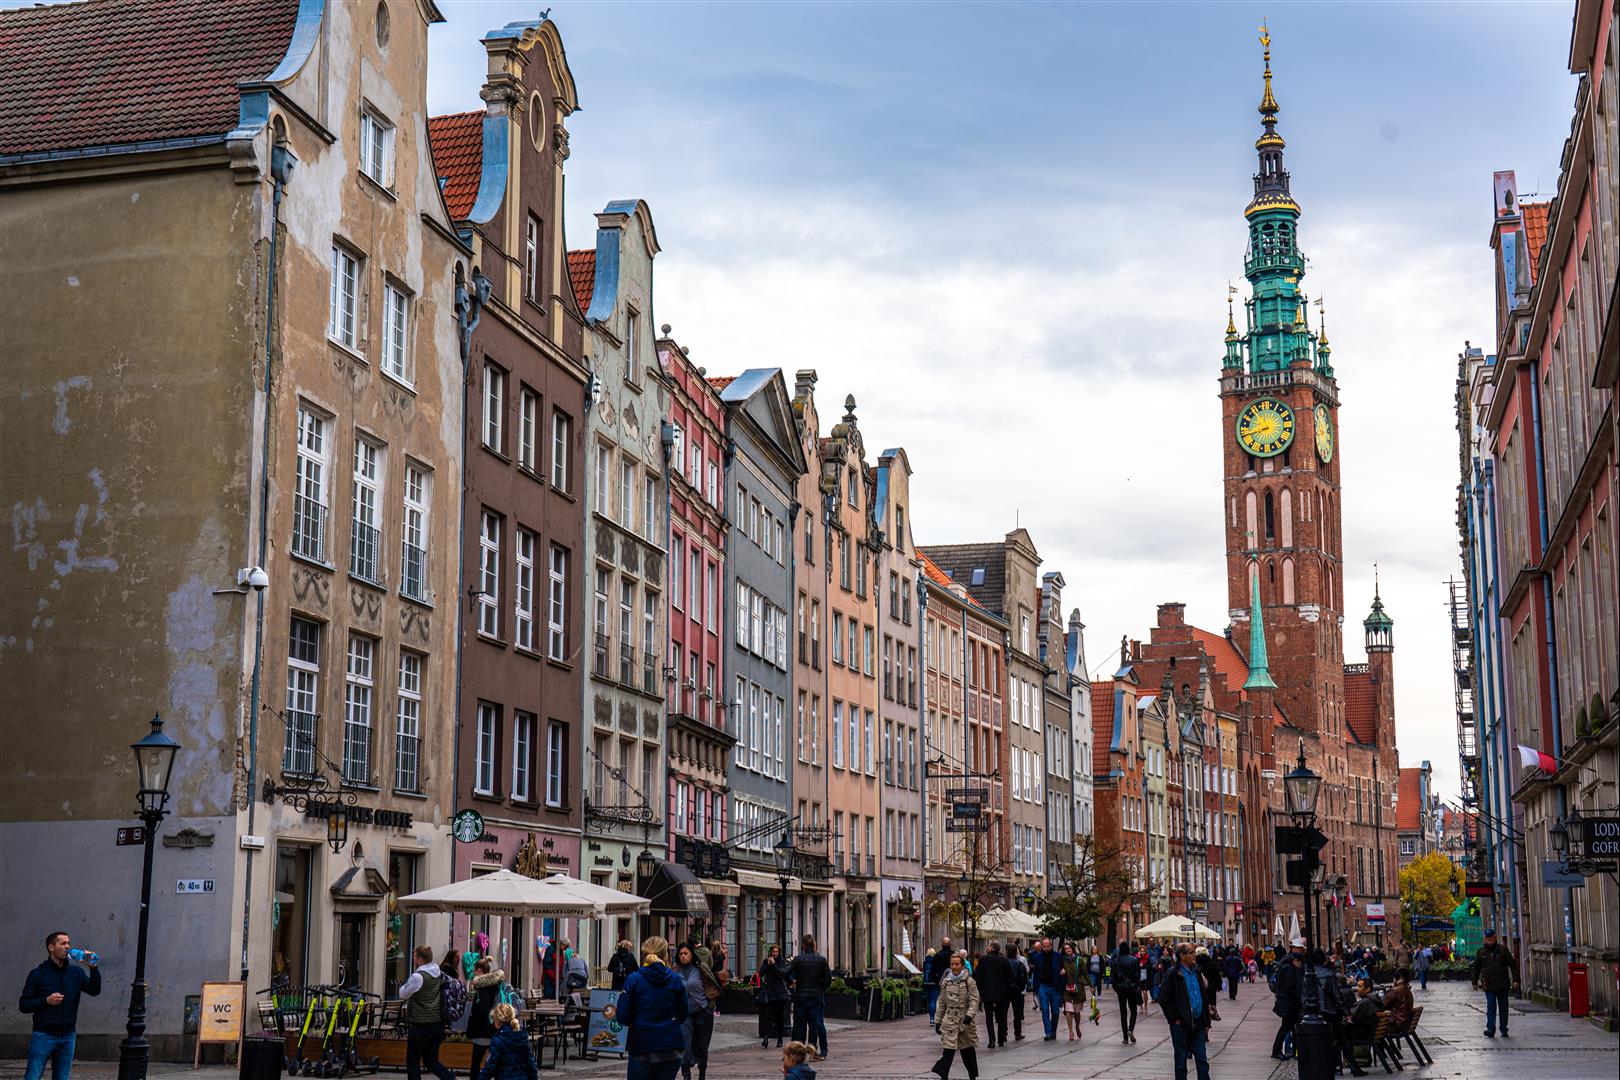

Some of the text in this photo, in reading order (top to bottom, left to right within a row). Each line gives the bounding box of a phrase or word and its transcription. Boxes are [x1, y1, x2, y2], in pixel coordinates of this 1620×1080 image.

[1594, 822, 1619, 837] LODY
[1592, 841, 1619, 854] GOFR
[213, 1004, 232, 1013] WC
